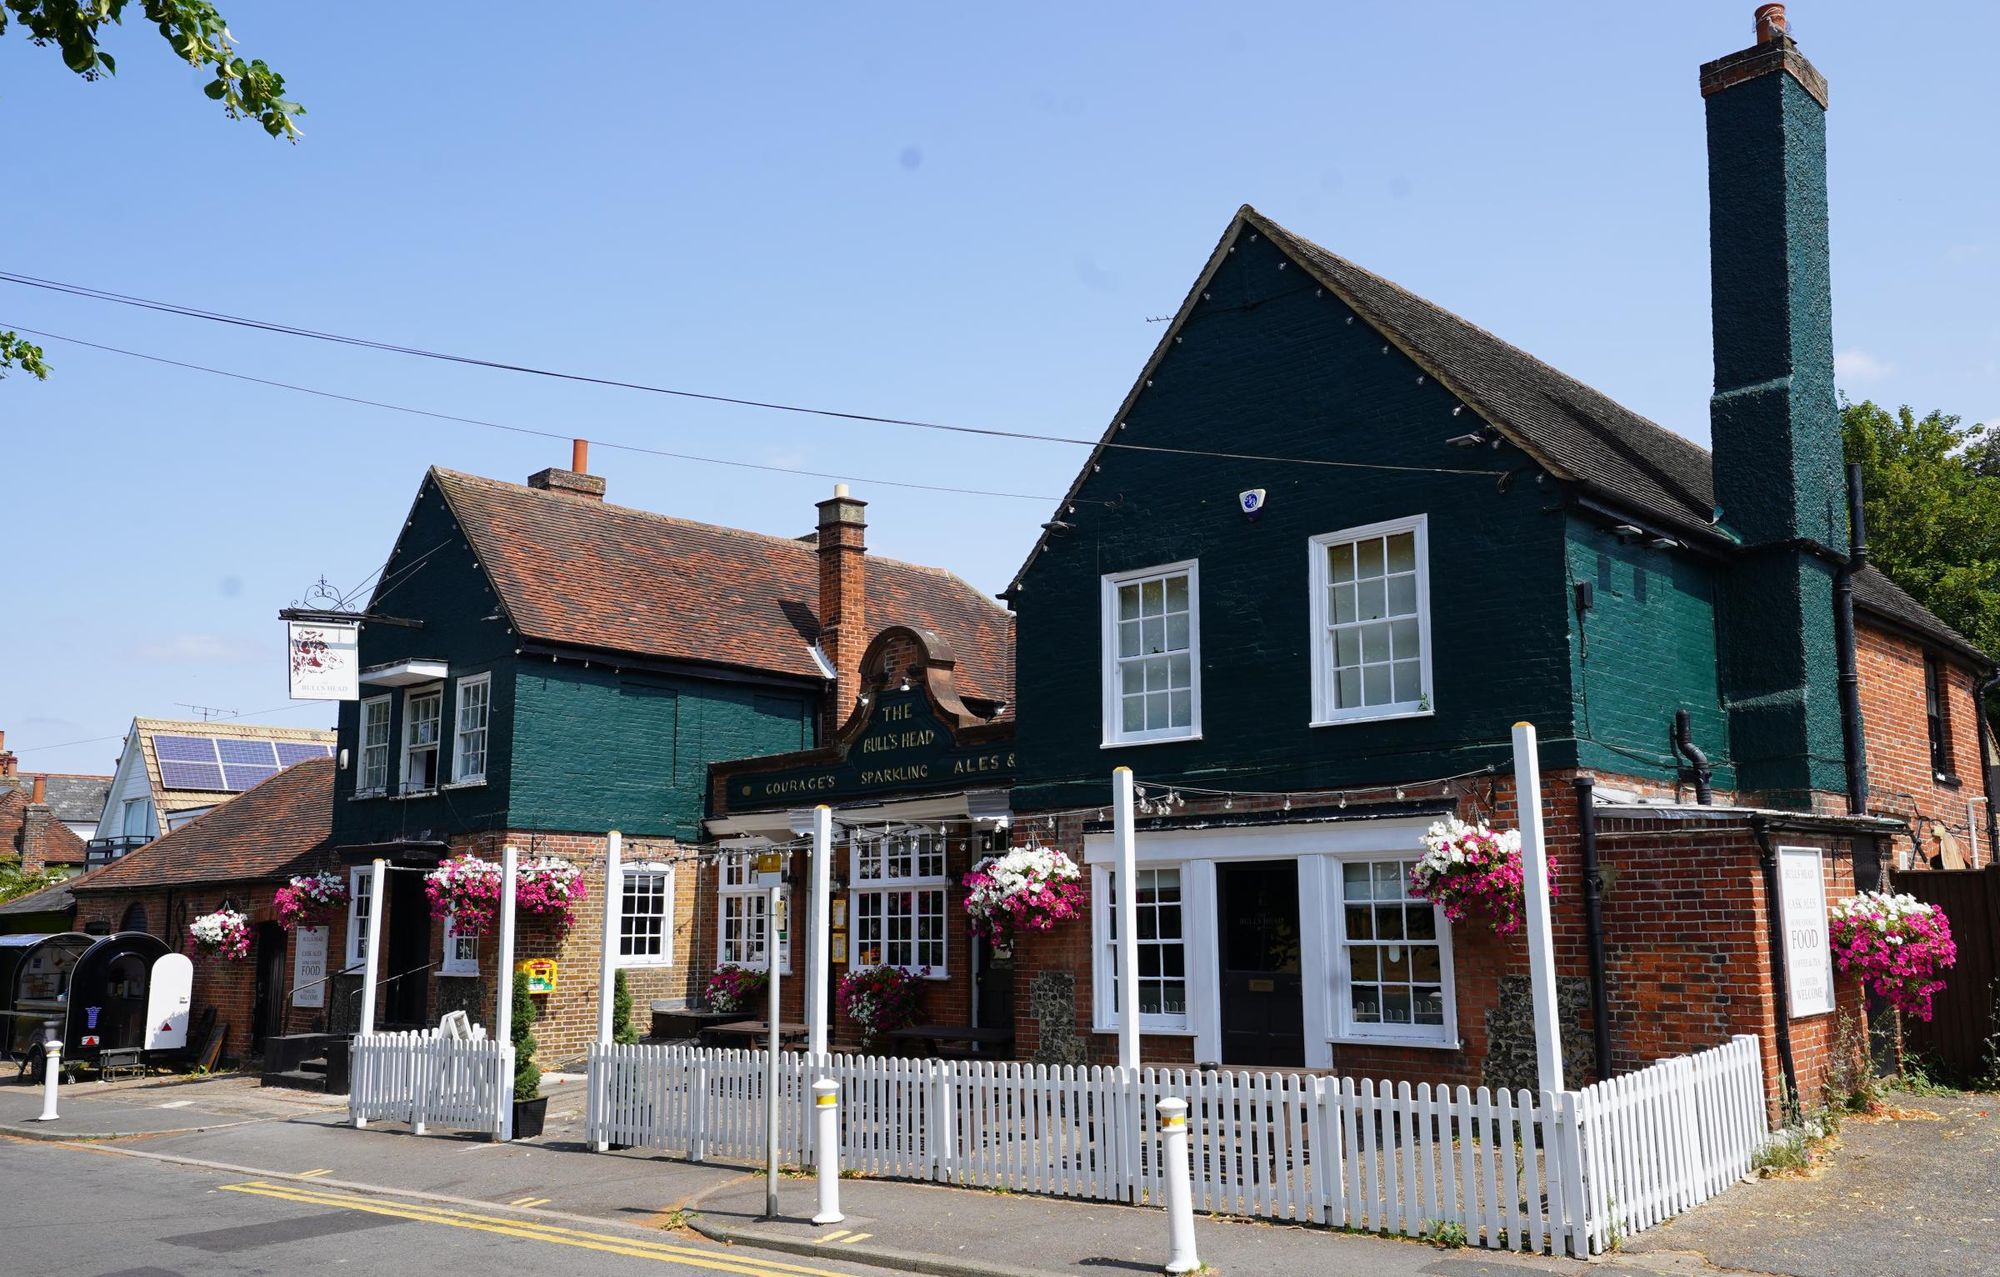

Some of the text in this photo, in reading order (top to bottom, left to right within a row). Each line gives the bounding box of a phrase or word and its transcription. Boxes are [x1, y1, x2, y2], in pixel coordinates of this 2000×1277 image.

[882, 703, 913, 722] THE
[863, 730, 935, 753] BULL'S HEAD
[766, 753, 1017, 795] COURAGE'S SPARKLING ALES &
[1791, 929, 1819, 950] FOOD
[301, 965, 321, 976] FOOD
[1796, 987, 1824, 1001] WELCOME
